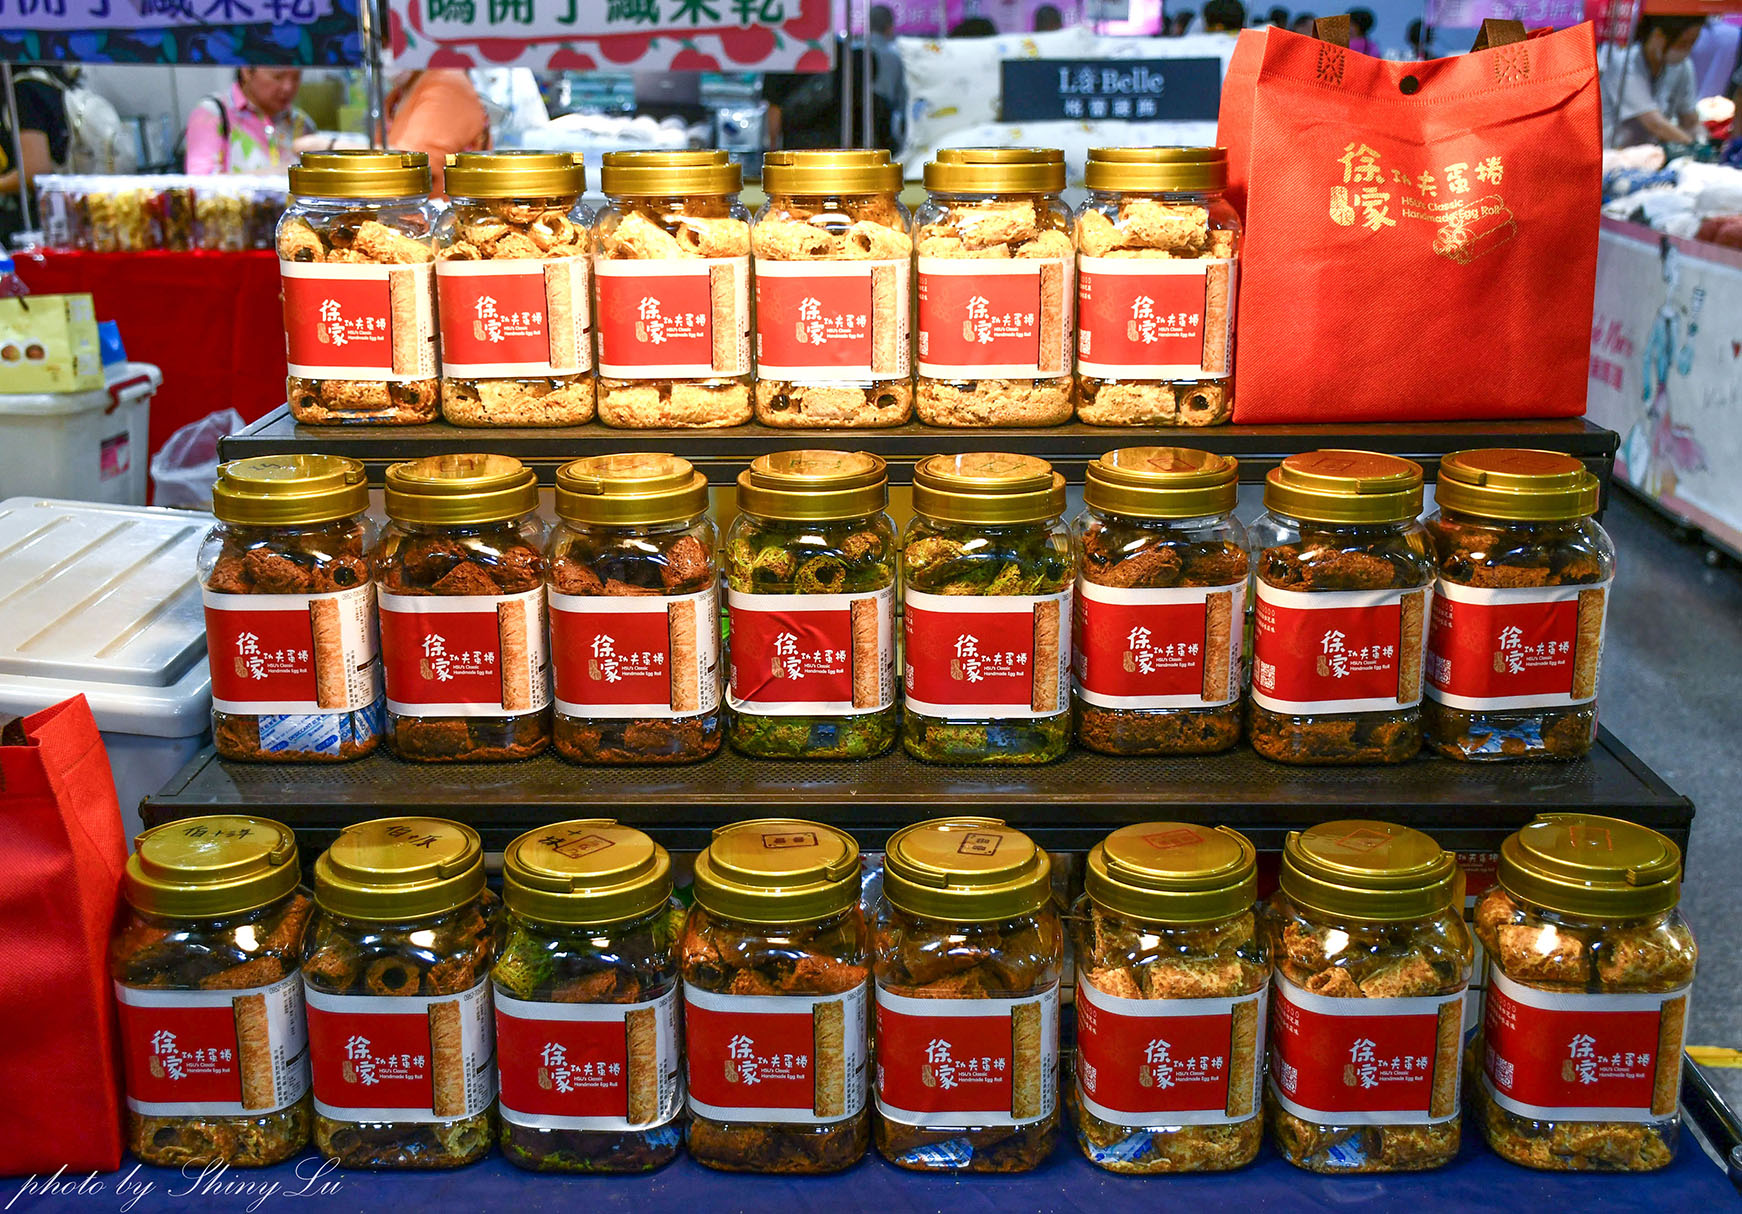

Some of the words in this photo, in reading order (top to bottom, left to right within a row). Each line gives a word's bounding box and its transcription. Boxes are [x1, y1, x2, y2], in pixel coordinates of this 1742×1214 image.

[1102, 66, 1164, 94] Belle
[1337, 142, 1396, 231] 徐家
[1427, 199, 1464, 211] Classic
[1458, 209, 1479, 220] Egg
[1481, 205, 1500, 216] Roll
[319, 299, 348, 346] 徐家
[474, 295, 504, 343] 徐家
[638, 297, 666, 345] 徐家
[798, 297, 827, 346] 徐家
[966, 296, 994, 344] 徐家
[1130, 296, 1159, 344] 徐家
[235, 632, 268, 680] 徐家
[421, 634, 453, 682] 徐家
[591, 634, 622, 683] 徐家
[774, 632, 804, 681] 徐家
[954, 634, 984, 683] 徐家
[1126, 626, 1156, 675] 徐家
[1320, 629, 1351, 679] 徐家
[1497, 625, 1527, 675] 徐家
[150, 1030, 187, 1081] 徐家
[344, 1036, 379, 1086] 徐家
[541, 1043, 574, 1093] 徐家
[727, 1035, 761, 1085] 徐家
[925, 1039, 958, 1090] 徐家
[1143, 1039, 1176, 1090] 徐家
[1348, 1038, 1381, 1089] 徐家
[1566, 1034, 1601, 1085] 徐家
